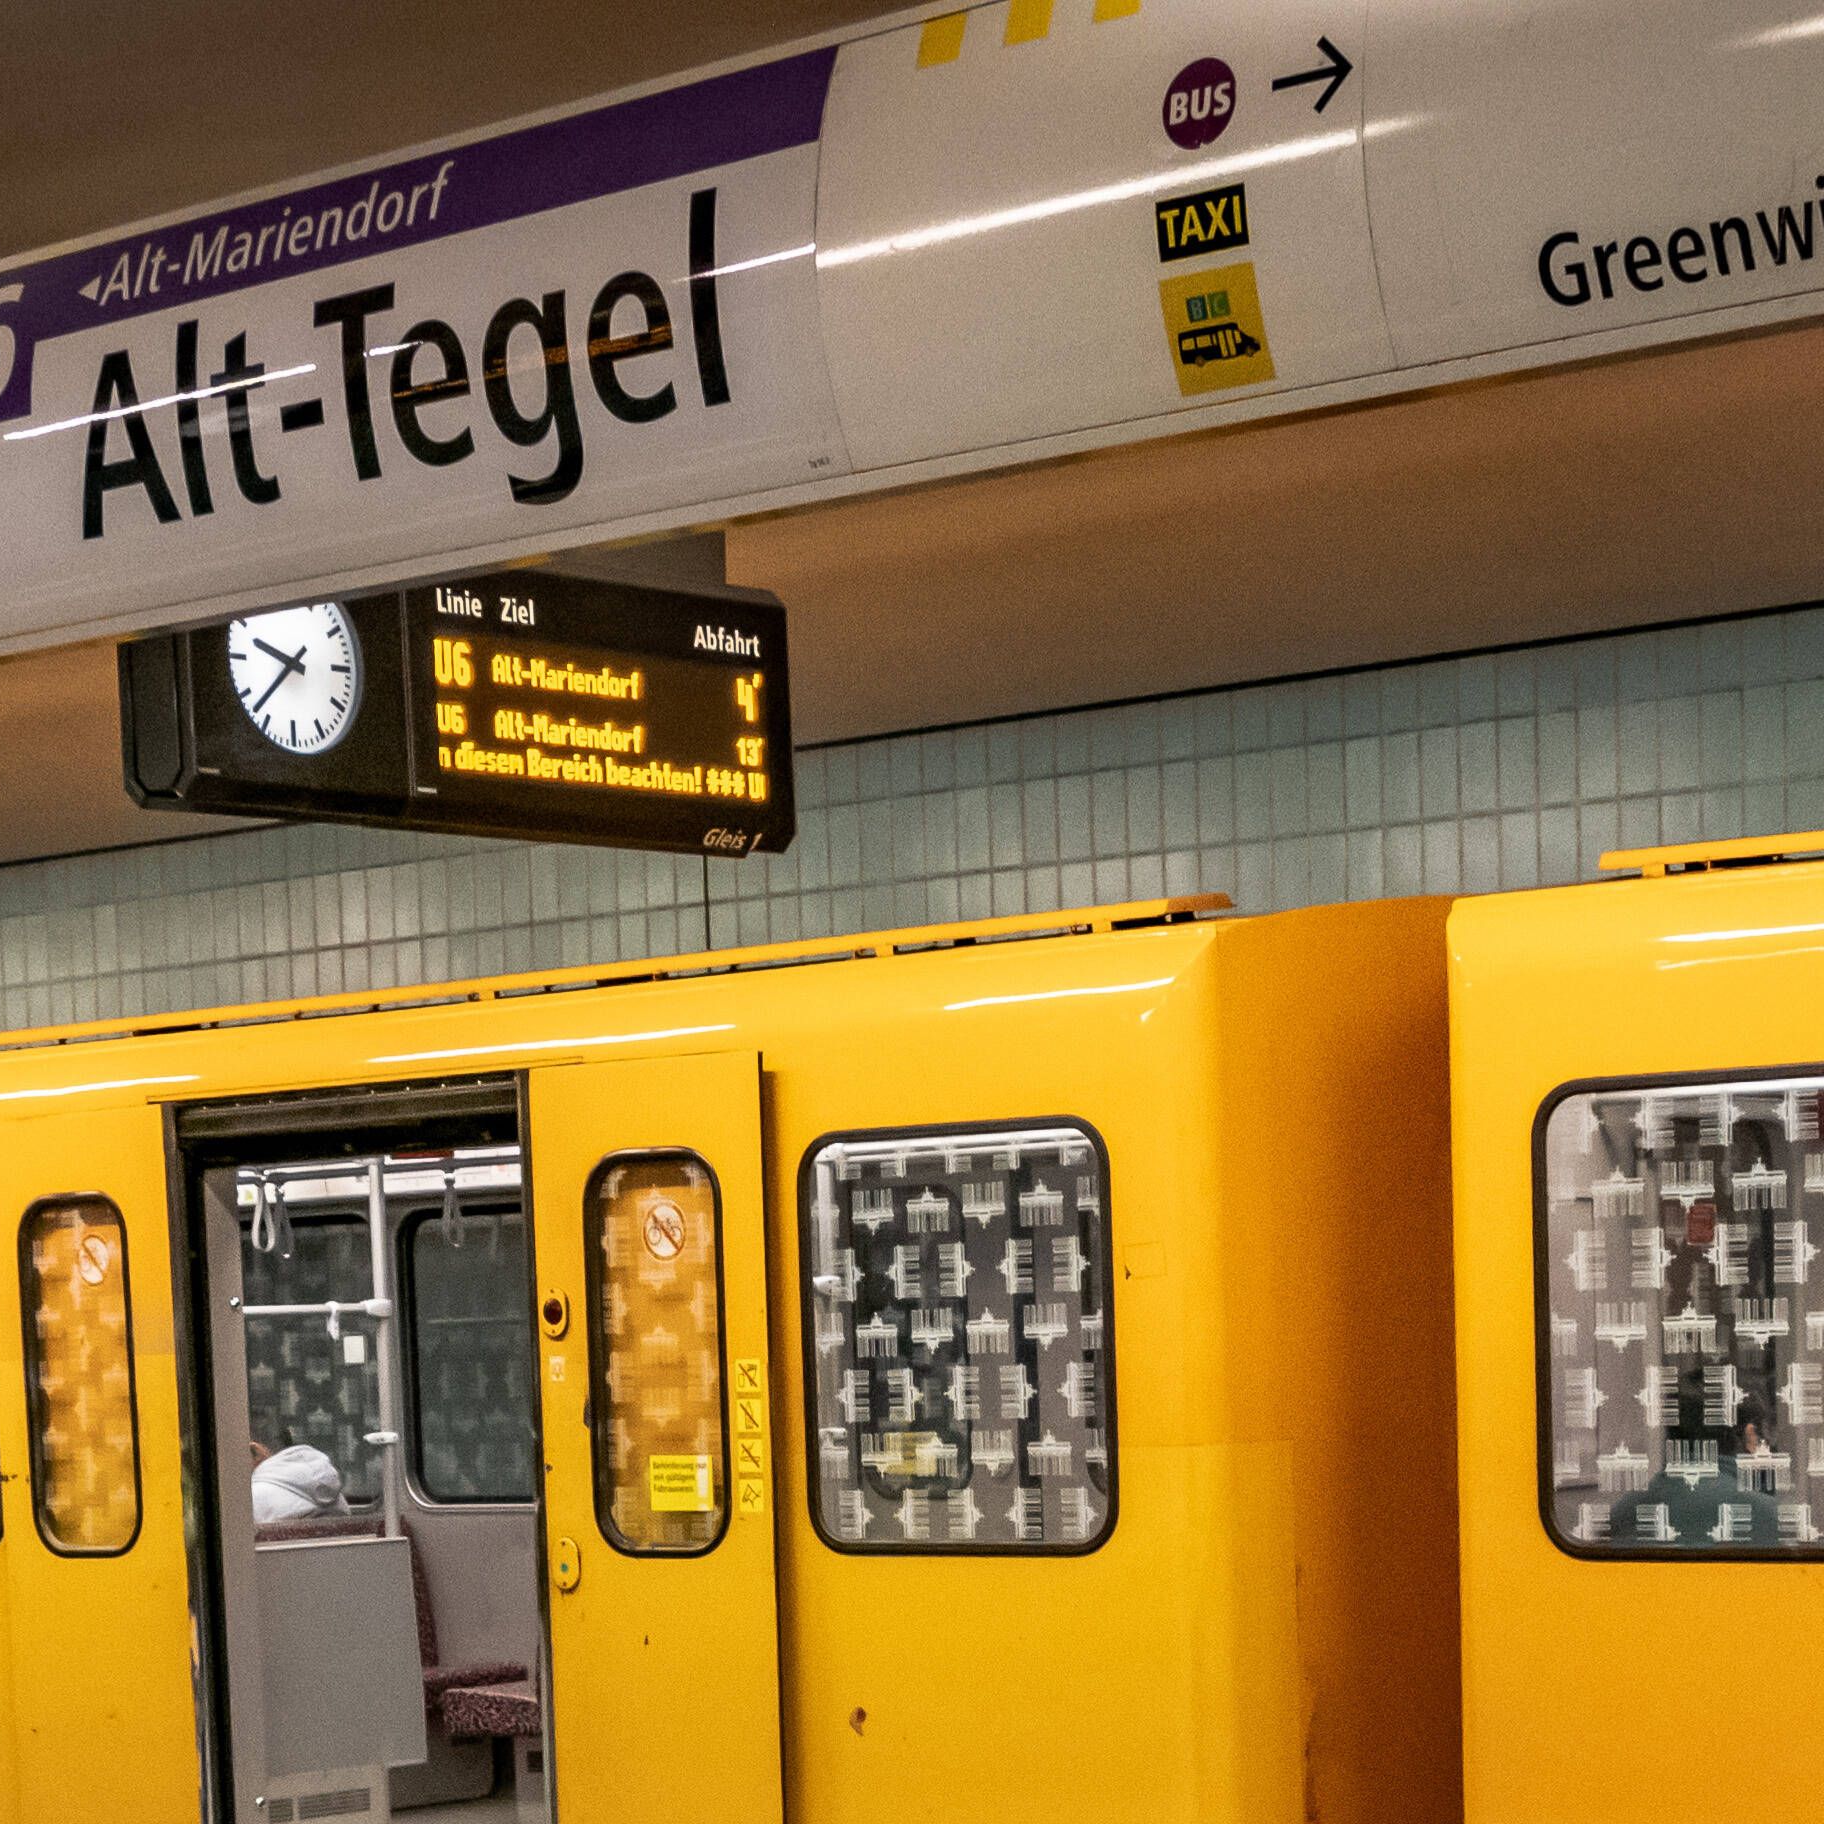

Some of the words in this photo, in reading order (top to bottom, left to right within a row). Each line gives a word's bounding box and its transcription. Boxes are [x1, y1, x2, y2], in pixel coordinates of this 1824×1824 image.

[1168, 81, 1232, 126] BUS
[99, 161, 455, 306] Alt-Mariendorf
[1160, 195, 1243, 249] TAXI
[82, 187, 732, 541] Alt-Tegel
[435, 588, 483, 618] Linie
[499, 597, 535, 626] Ziel
[694, 625, 761, 658] Abfahrt
[433, 638, 472, 687] U6
[491, 654, 641, 700] Alt-Mariendorf
[436, 703, 465, 734] U6
[494, 709, 643, 753] Alt-Mariendorf
[454, 741, 525, 775] diesen
[526, 748, 604, 783] Bereich
[605, 756, 702, 794] beachten!
[703, 828, 746, 851] Gleis
[749, 831, 763, 852] 1
